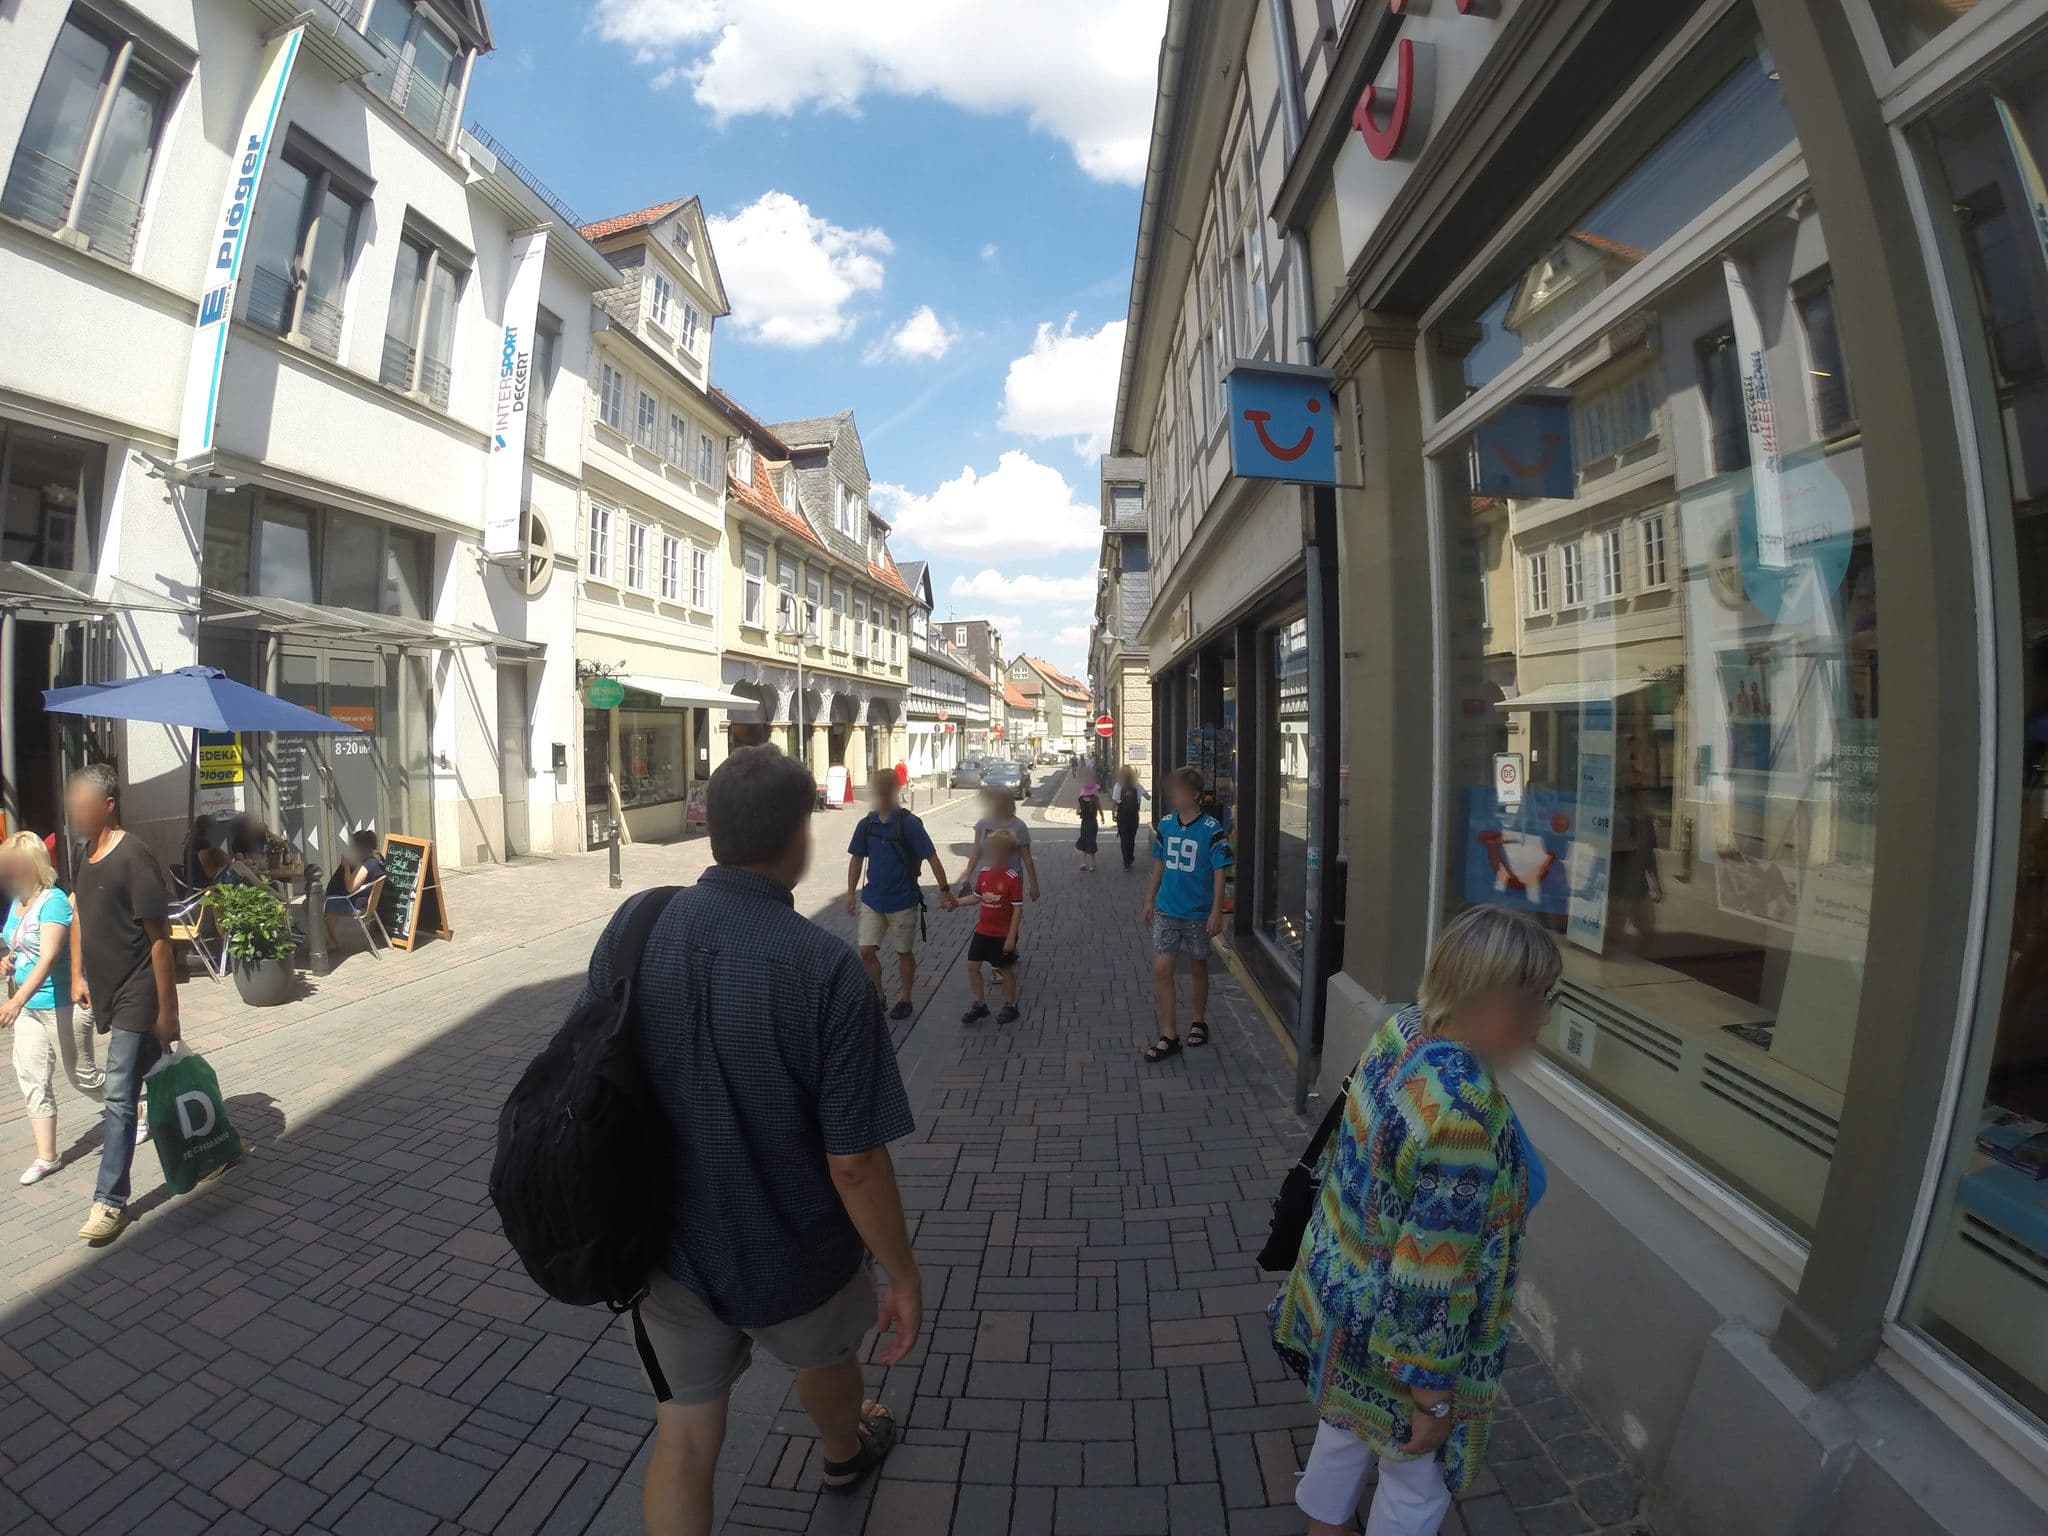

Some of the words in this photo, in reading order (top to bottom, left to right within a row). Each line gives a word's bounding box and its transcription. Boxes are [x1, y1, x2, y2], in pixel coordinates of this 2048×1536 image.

[216, 134, 261, 269] Plöger
[496, 325, 518, 432] INTERSPORT
[335, 742, 358, 755] 8-20
[1166, 836, 1198, 873] 59
[176, 1090, 216, 1140] D
